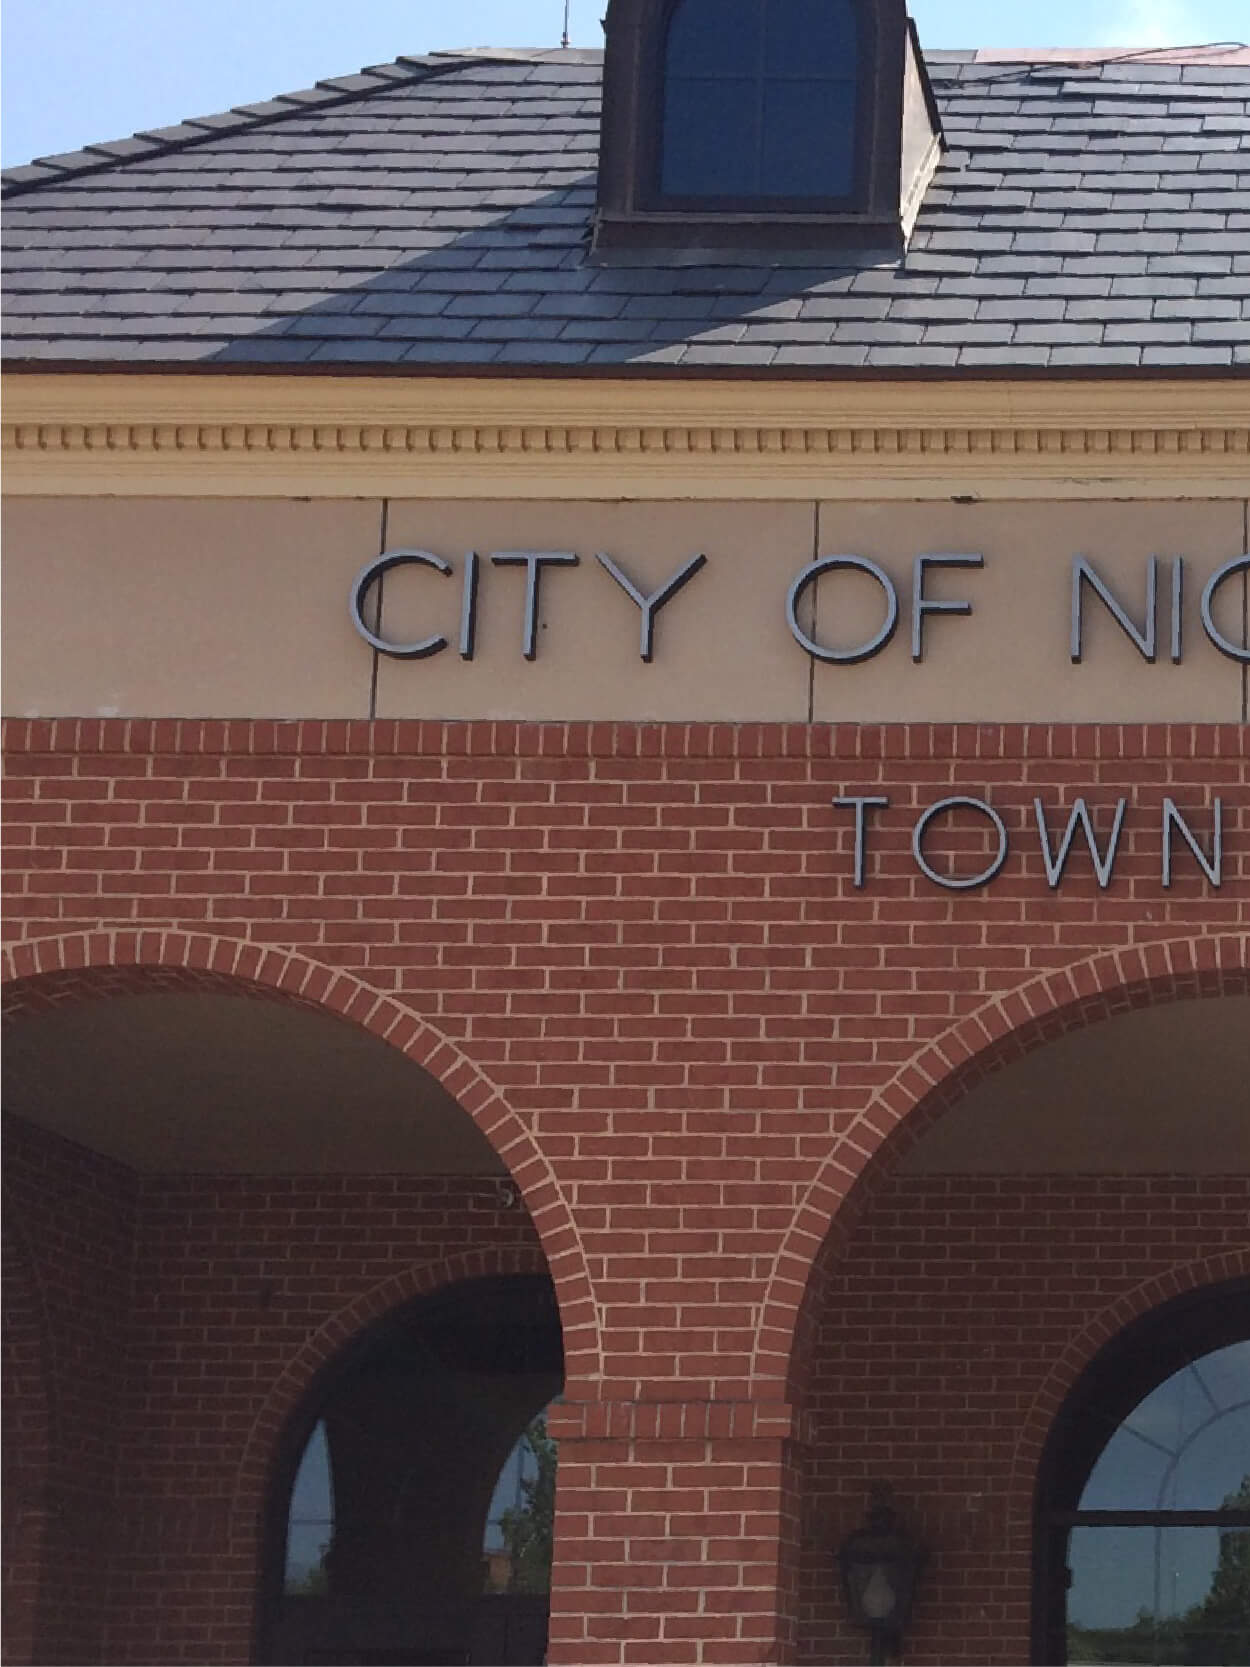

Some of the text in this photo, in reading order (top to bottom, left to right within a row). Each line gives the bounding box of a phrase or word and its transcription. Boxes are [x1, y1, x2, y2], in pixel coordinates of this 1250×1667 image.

[349, 549, 706, 662] CITY
[785, 552, 984, 665] OF
[832, 796, 1223, 889] TOWN
